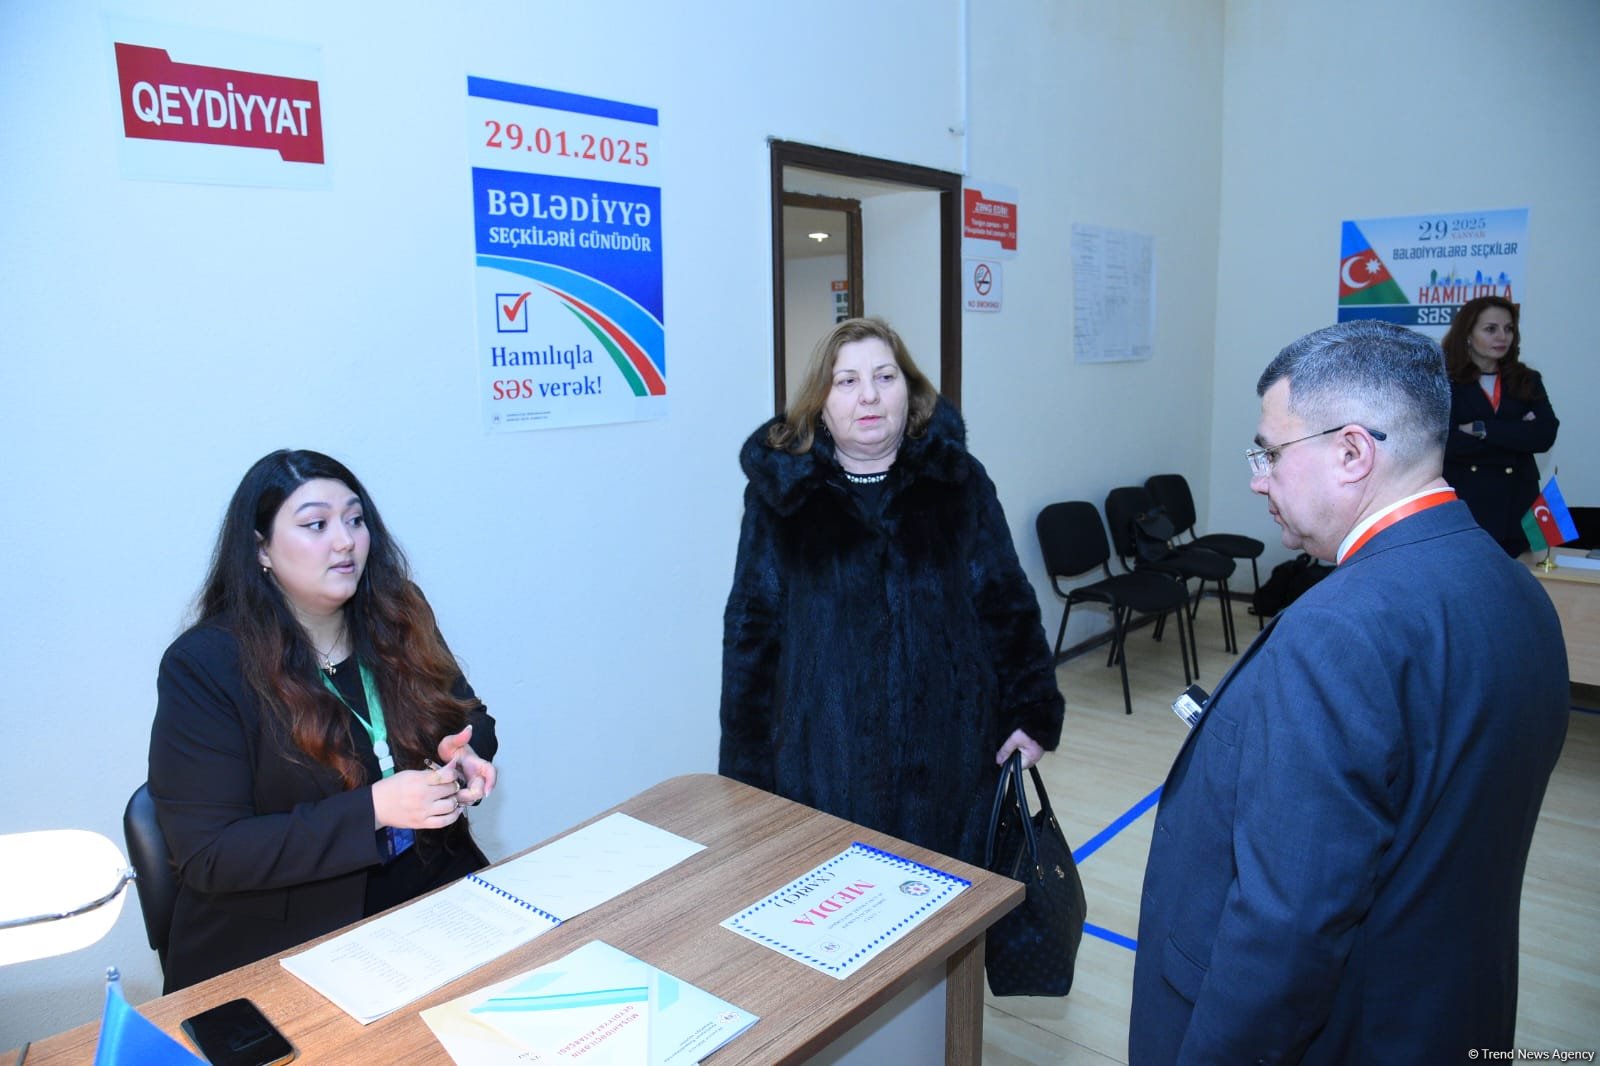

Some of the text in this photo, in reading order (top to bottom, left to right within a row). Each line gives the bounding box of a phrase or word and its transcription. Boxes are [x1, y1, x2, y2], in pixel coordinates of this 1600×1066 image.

[132, 81, 312, 137] QEYDİYYAT
[485, 120, 649, 167] 29.01.2025
[487, 189, 651, 227] BƏLƏDİYYƏ
[489, 226, 652, 252] SEÇKİLƏRİ GÜNÜDÜR
[1418, 218, 1486, 241] 29 2025
[1471, 242, 1518, 259] SEÇKİLƏR
[491, 344, 593, 369] Hamılıqla
[493, 376, 602, 401] SƏS verək!
[792, 880, 875, 925] MEDIA
